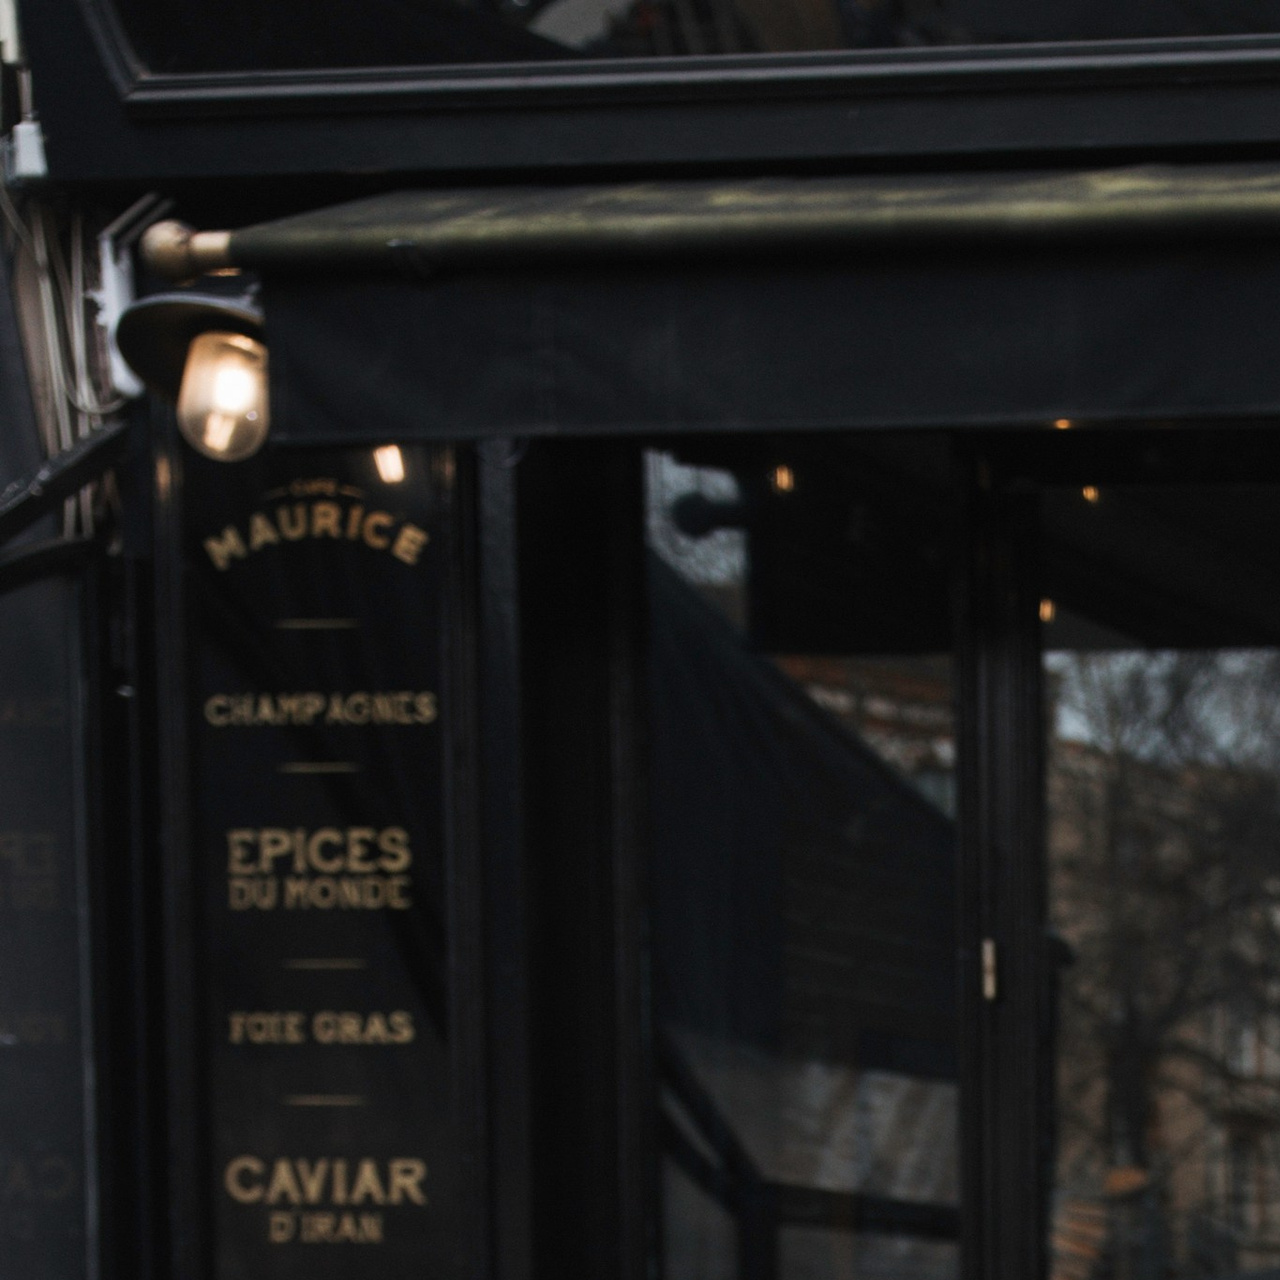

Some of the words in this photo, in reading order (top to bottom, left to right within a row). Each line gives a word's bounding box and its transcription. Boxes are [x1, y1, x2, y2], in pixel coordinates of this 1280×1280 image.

[204, 501, 430, 571] MAURICE
[205, 691, 437, 726] CHAMPAGNES
[228, 827, 411, 873] EPICES
[229, 877, 276, 910] DU
[286, 877, 411, 910] MONDE
[229, 1012, 303, 1044] FOIE
[314, 1012, 415, 1044] GRAS
[225, 1157, 427, 1205] CAVIAR
[269, 1211, 383, 1244] D'IRAN
